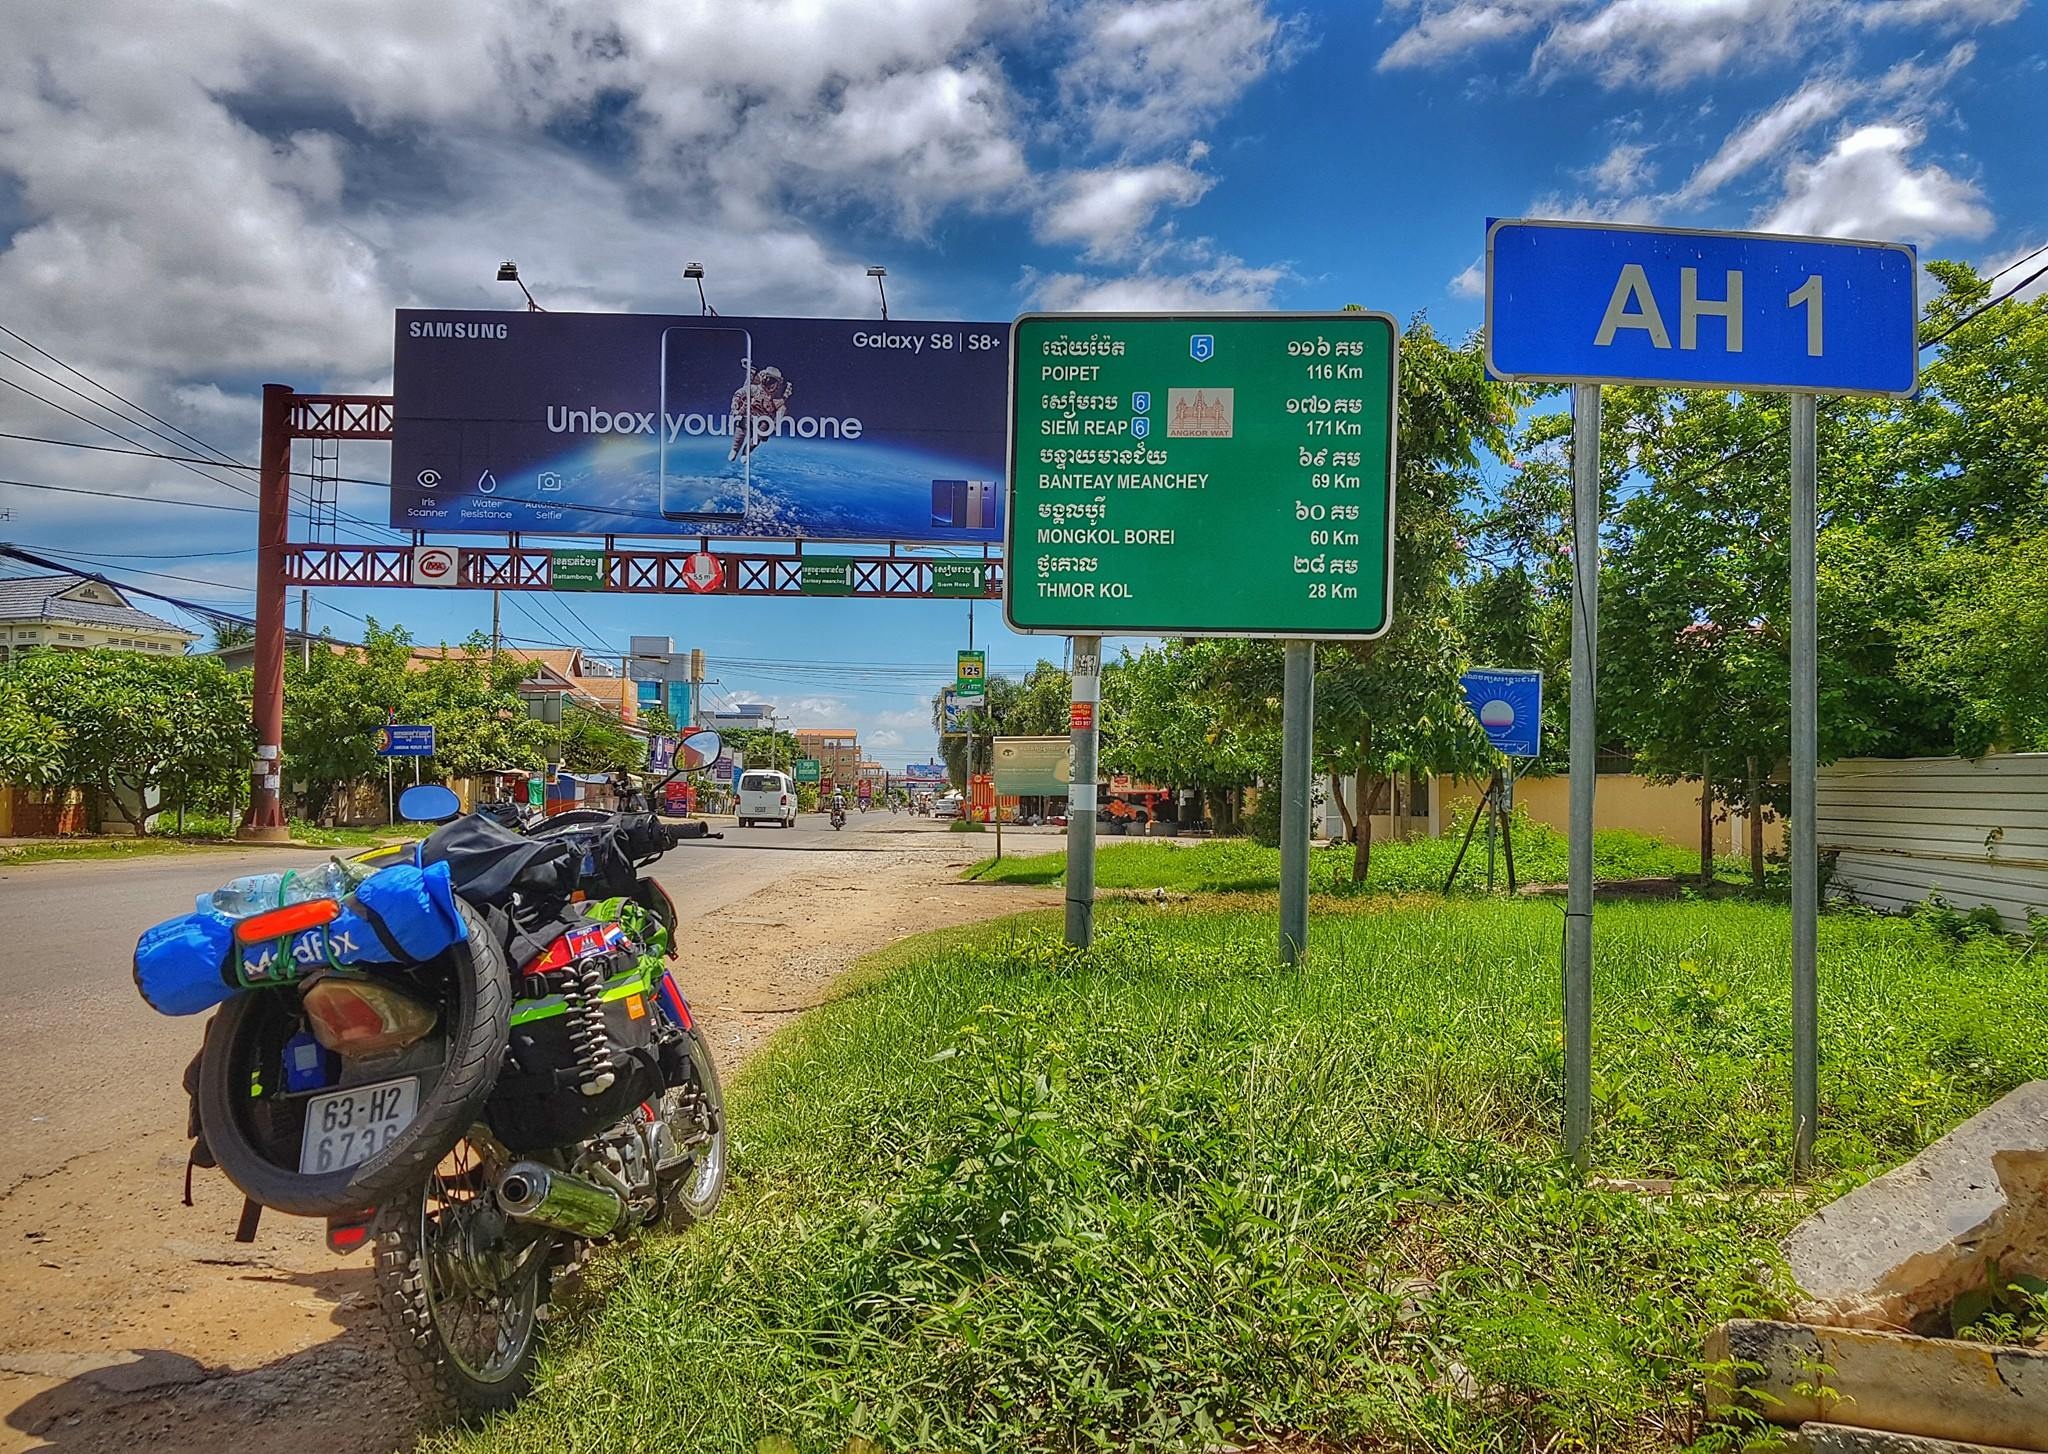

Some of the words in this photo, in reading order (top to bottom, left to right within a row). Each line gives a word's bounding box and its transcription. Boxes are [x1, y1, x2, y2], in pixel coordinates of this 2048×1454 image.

[1593, 264, 1742, 352] AH
[1788, 275, 1823, 356] 1
[410, 322, 507, 339] SAMSUNG
[853, 332, 924, 354] Galaxy
[930, 334, 954, 350] S8
[968, 335, 1001, 350] S8+
[1196, 338, 1208, 356] 5
[1287, 336, 1331, 357] ១១៦
[1335, 341, 1364, 357] គម
[1041, 366, 1100, 381] POIPET
[1306, 364, 1332, 380] 116
[1337, 364, 1363, 380] Km
[1042, 391, 1119, 418] សៀមរាប
[1136, 395, 1146, 411] 6
[1286, 395, 1331, 414] ១៧១
[1334, 399, 1363, 414] គម
[547, 406, 655, 435] Unbox
[665, 410, 736, 443] your
[751, 413, 863, 444] phone
[1041, 420, 1079, 436] SIEM
[1085, 420, 1128, 436] REAP
[1135, 420, 1145, 436] 6
[1306, 421, 1332, 436] 171
[1335, 420, 1362, 436] Km
[1299, 446, 1327, 467] ៦៩
[1332, 451, 1361, 467] គម
[1039, 474, 1113, 489] BANTEAY
[1117, 474, 1209, 489] MEANCHEY
[1311, 473, 1330, 489] 69
[1334, 473, 1360, 489] Km
[421, 498, 436, 507] Iris
[471, 499, 502, 508] Water
[407, 508, 448, 518] Scanner
[461, 509, 513, 519] Resistance
[535, 511, 563, 520] Selfie
[1295, 501, 1326, 520] ៦០
[1330, 505, 1360, 521] គម
[1038, 529, 1119, 544] MONGKOL
[1124, 529, 1175, 545] BOREI
[1310, 530, 1329, 545] 60
[1333, 530, 1359, 545] Km
[1293, 553, 1326, 574] ២៨
[1329, 558, 1359, 574] គម
[1037, 582, 1095, 598] THMOR
[1099, 583, 1133, 598] KOL
[1308, 583, 1327, 599] 28
[1331, 583, 1358, 599] Km
[962, 667, 980, 676] 125
[322, 1087, 401, 1133] 63-H2
